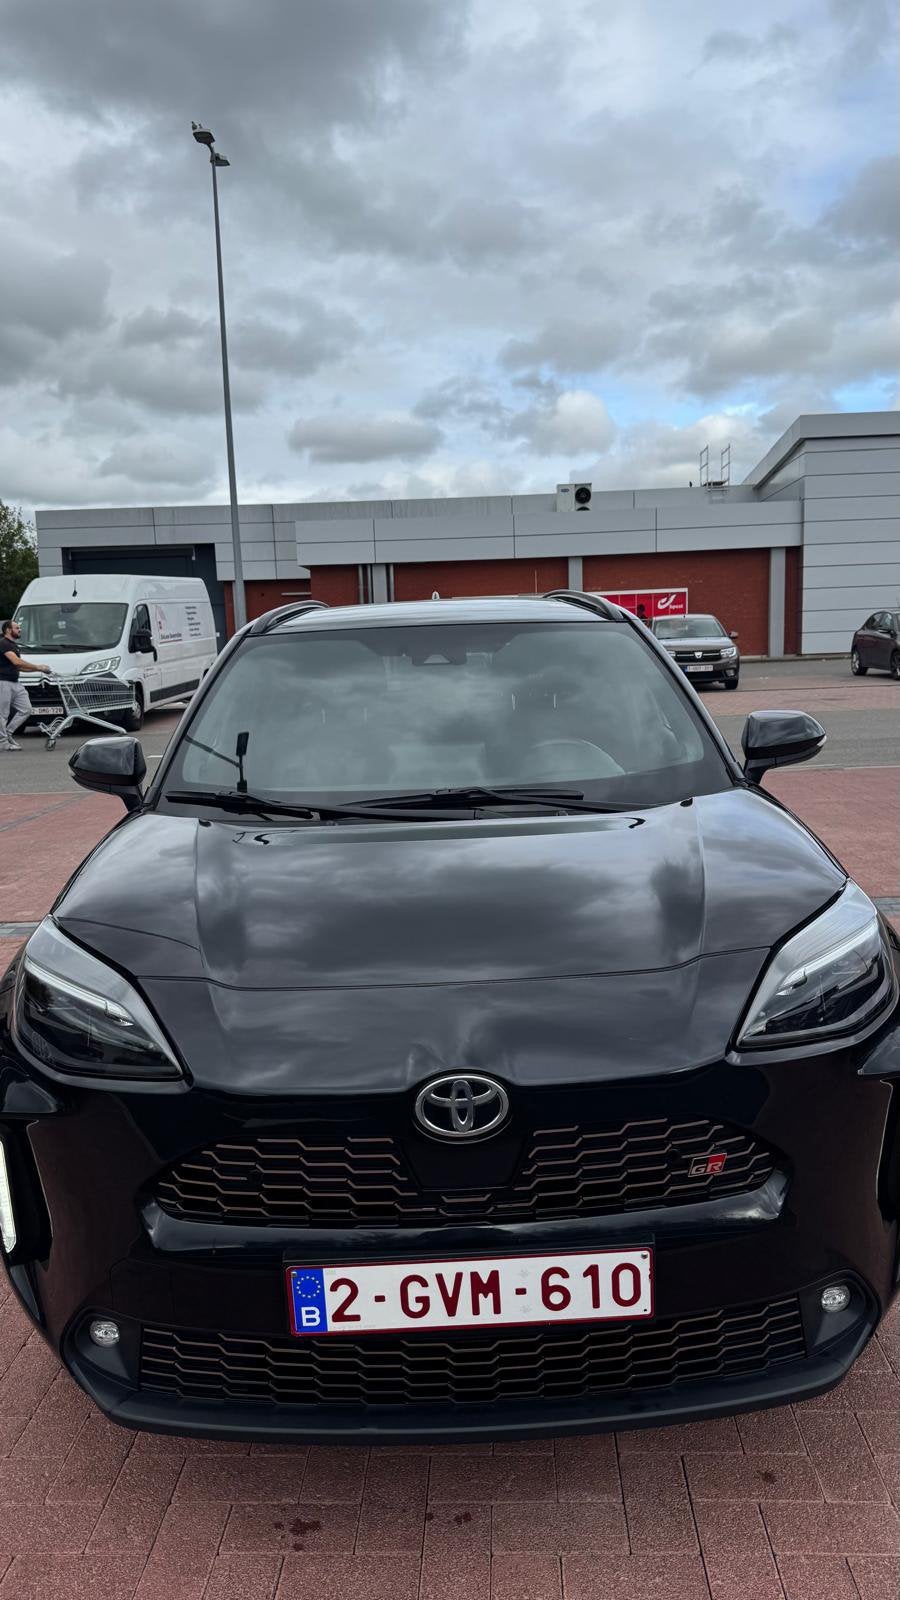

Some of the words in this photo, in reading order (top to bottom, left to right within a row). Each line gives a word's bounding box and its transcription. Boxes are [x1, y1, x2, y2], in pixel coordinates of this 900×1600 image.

[690, 1161, 722, 1175] GR
[329, 1262, 642, 1323] 2-GVM-610
[301, 1306, 321, 1327] B
